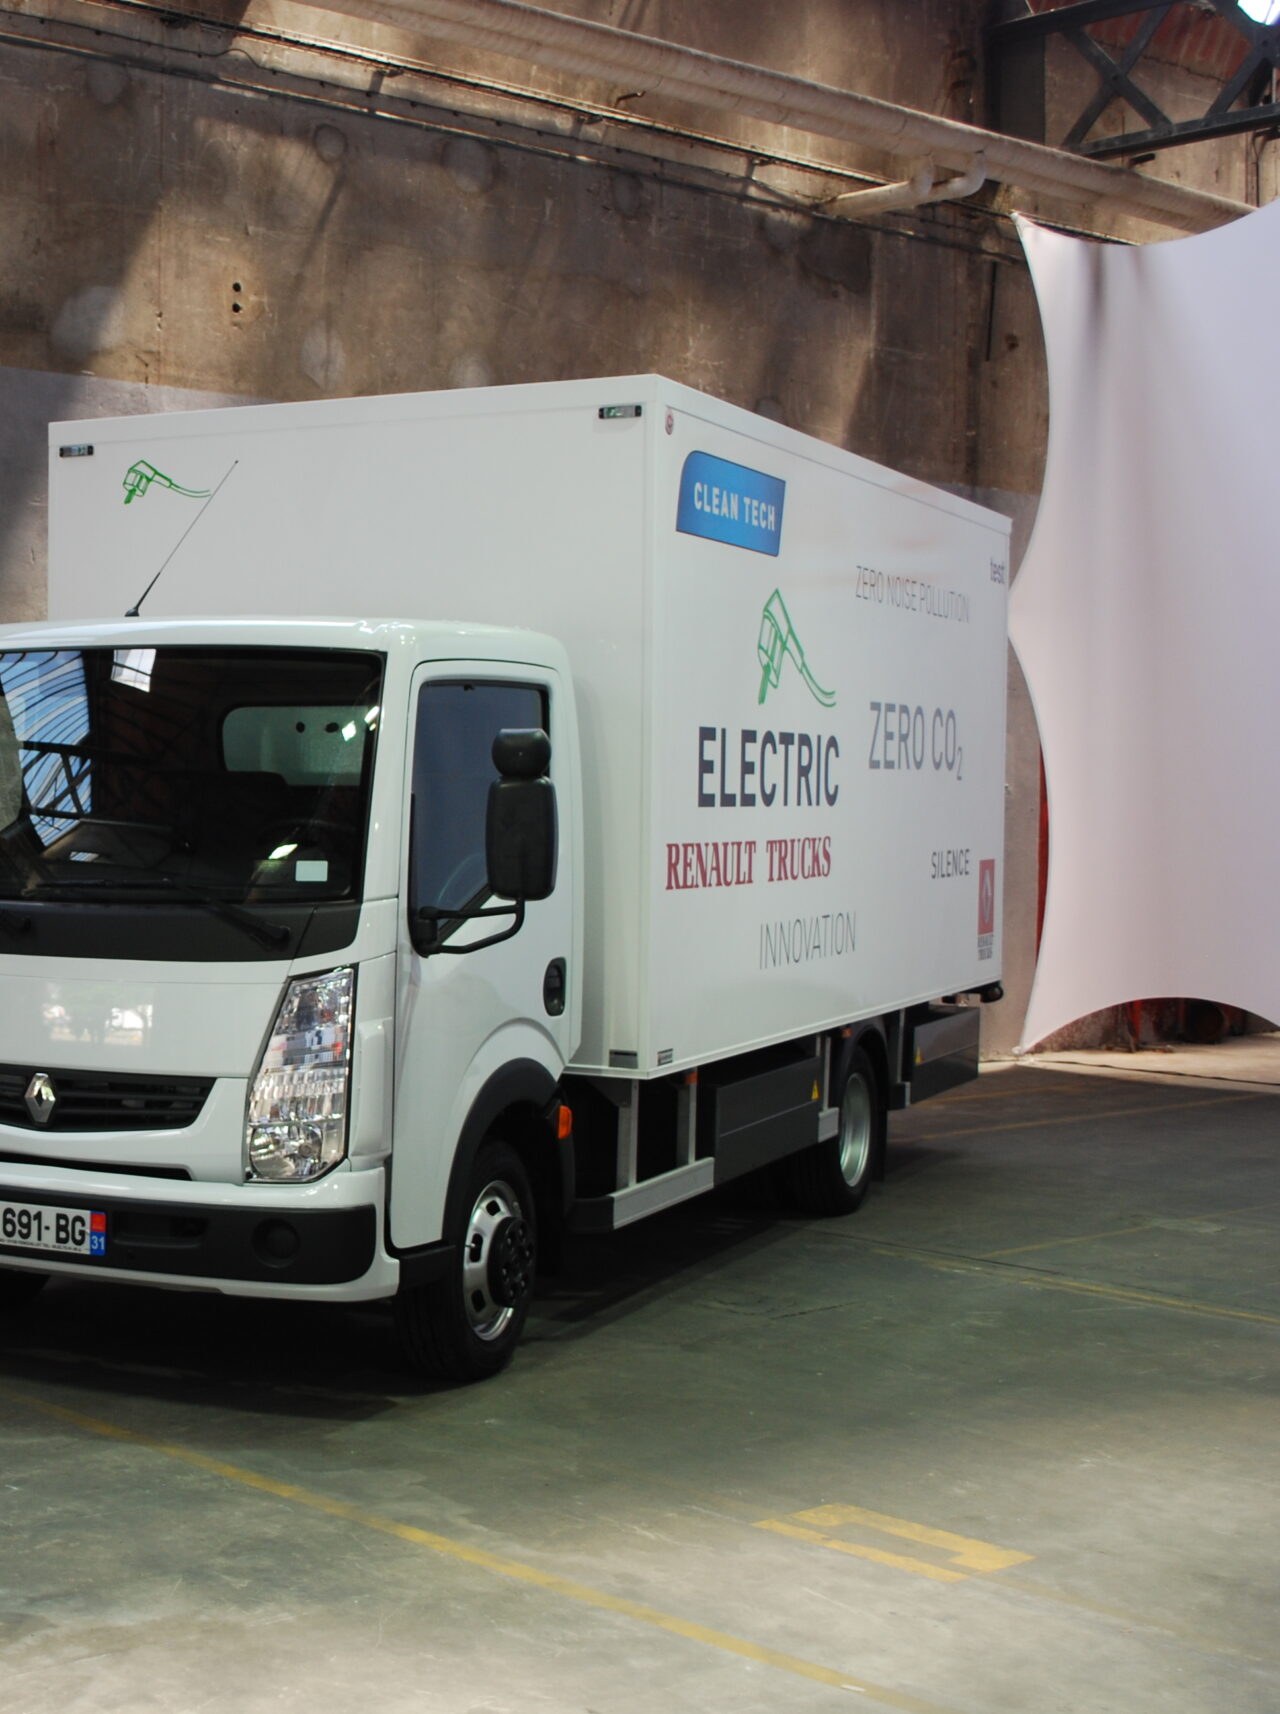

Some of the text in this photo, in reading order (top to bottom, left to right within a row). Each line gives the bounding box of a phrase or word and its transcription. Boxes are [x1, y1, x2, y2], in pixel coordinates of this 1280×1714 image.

[694, 481, 776, 532] CLEAN TECH
[855, 564, 970, 624] ZERO NOISE POLLUTION
[869, 701, 925, 771] ZERO
[697, 726, 840, 808] ELECTRIC
[665, 835, 832, 890] RENAULT TRUCKS
[931, 848, 970, 879] SILENCE
[759, 911, 856, 970] INNOVATION
[91, 1235, 106, 1251] 31
